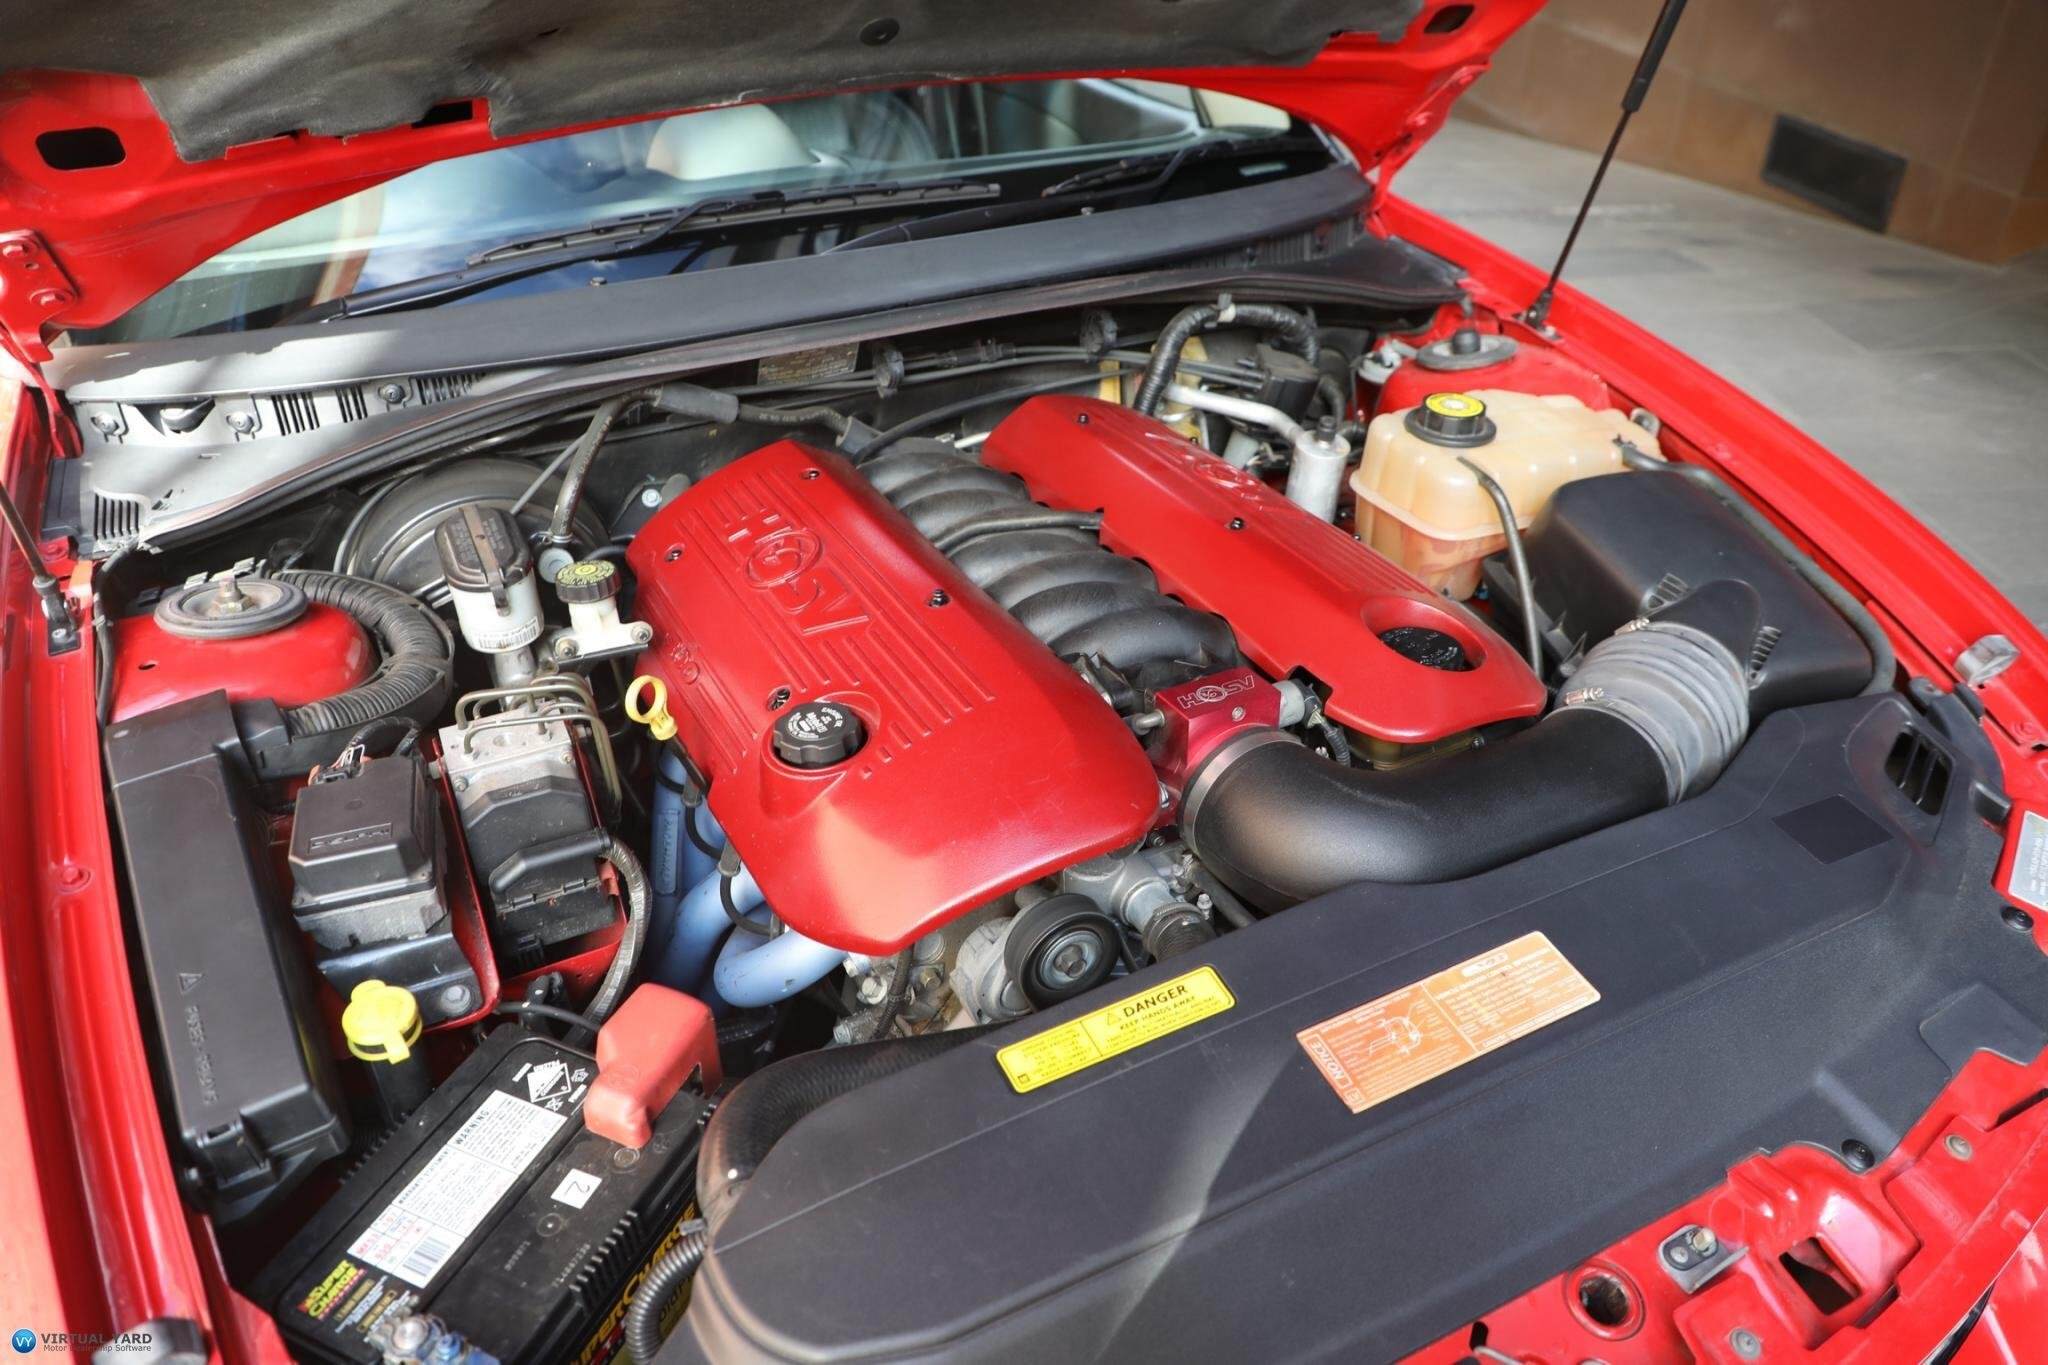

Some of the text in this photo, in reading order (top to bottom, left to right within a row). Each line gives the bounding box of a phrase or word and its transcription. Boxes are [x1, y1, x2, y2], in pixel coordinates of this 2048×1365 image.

[1177, 674, 1255, 709] HSV
[1119, 996, 1196, 1031] KEEP HANDS AWAY
[1123, 985, 1188, 1018] DANGER
[1310, 1041, 1346, 1078] NOTICE
[563, 1180, 591, 1198] 2
[307, 1259, 351, 1301] SUPER
[309, 1266, 359, 1318] CHARGE
